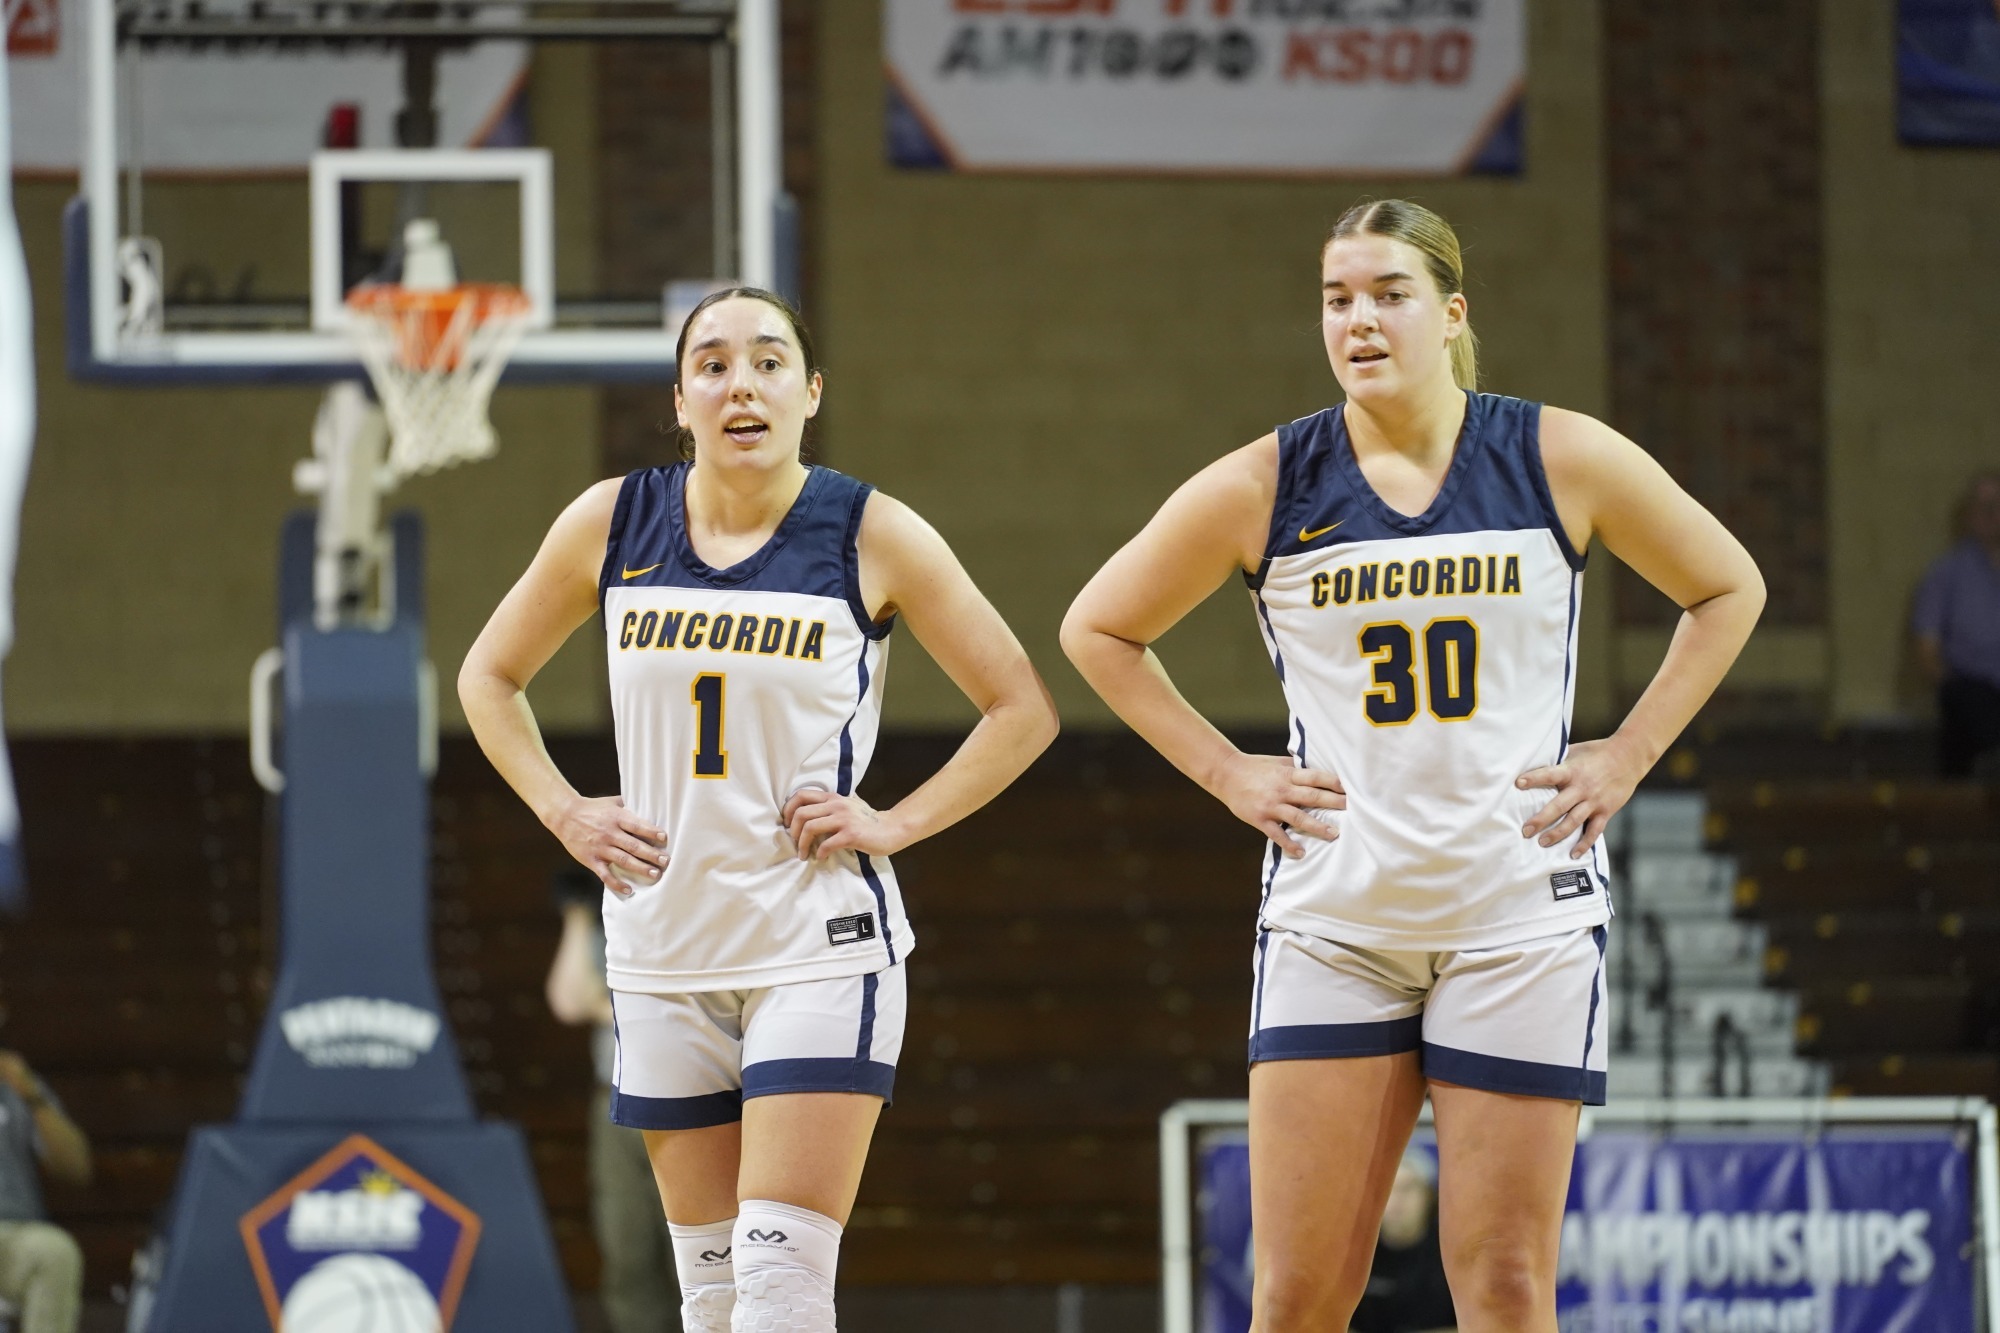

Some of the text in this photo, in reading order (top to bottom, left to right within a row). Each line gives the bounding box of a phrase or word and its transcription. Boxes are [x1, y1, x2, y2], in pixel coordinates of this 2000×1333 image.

[1311, 554, 1522, 609] CONCORDIA
[619, 608, 827, 662] CONCORDIA
[1356, 615, 1480, 728] 30
[690, 671, 729, 780] 1
[1578, 877, 1588, 887] XL
[862, 922, 868, 932] L
